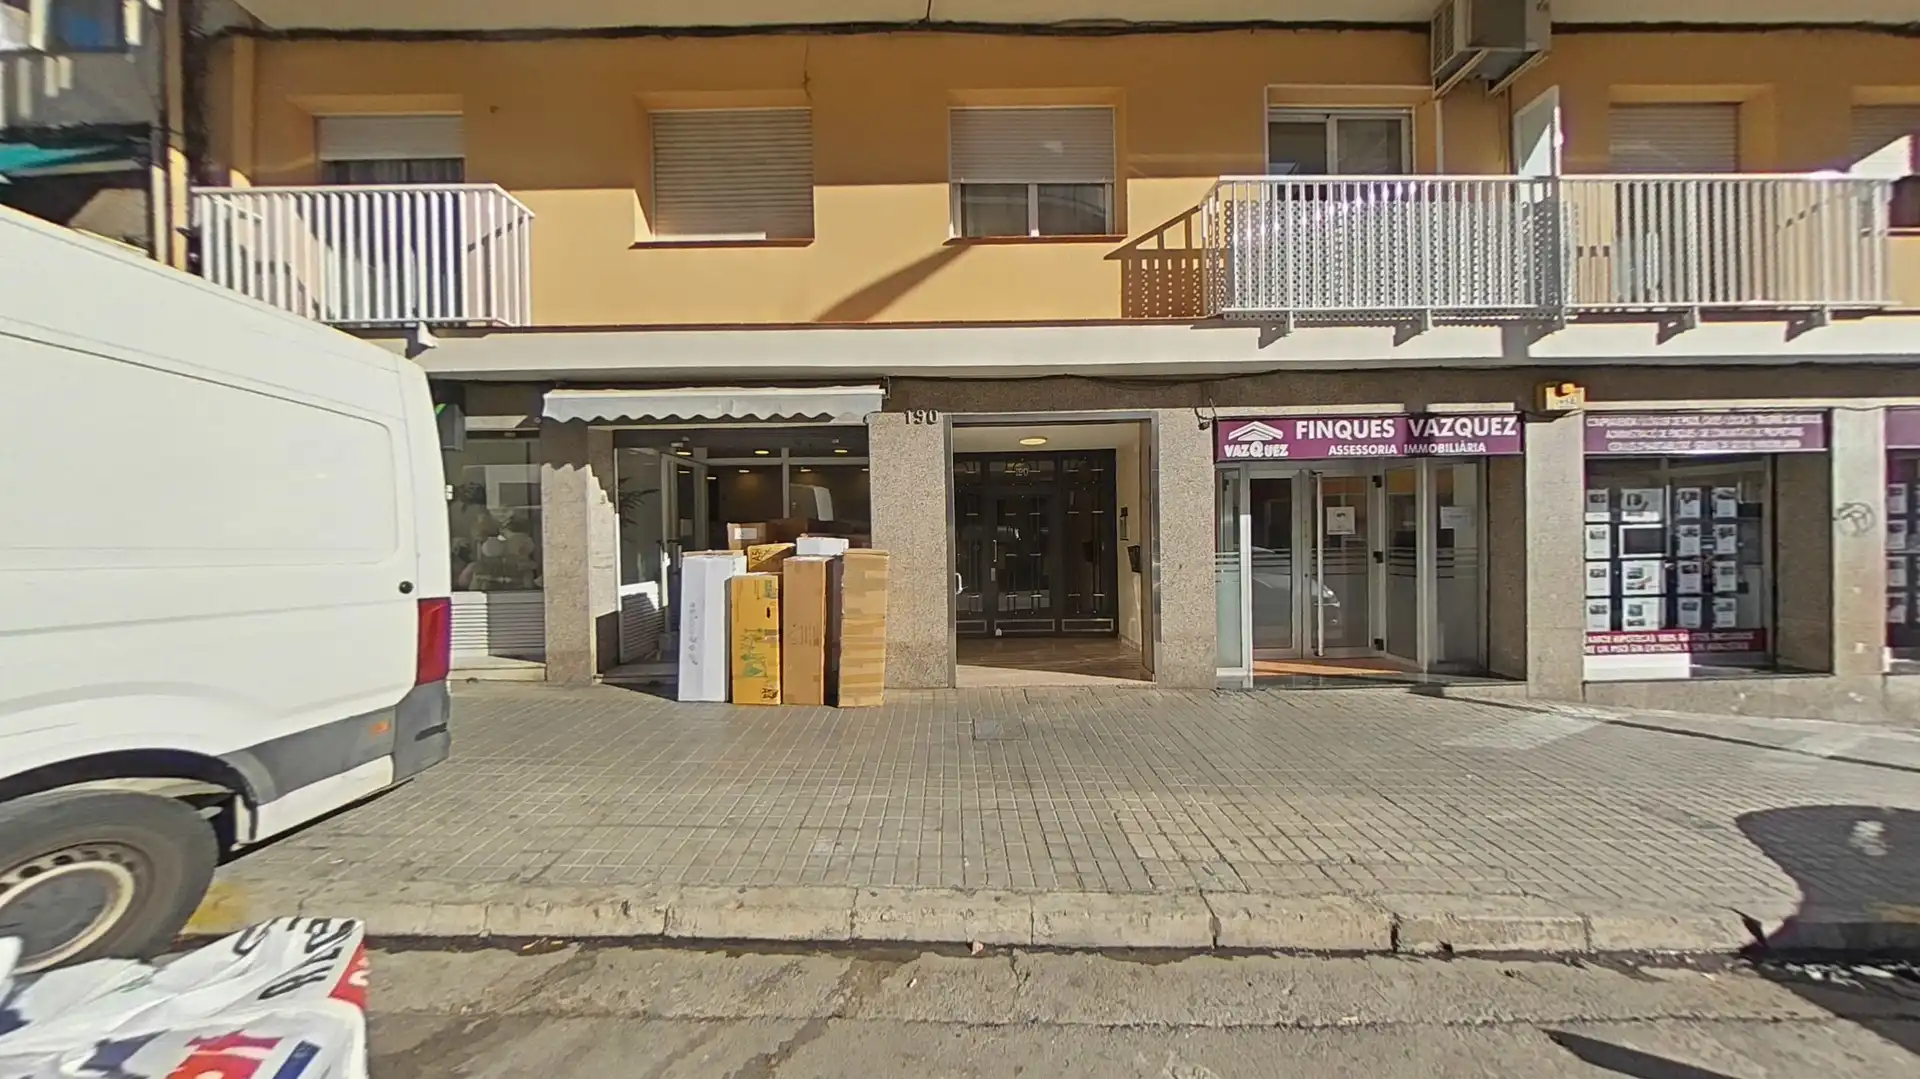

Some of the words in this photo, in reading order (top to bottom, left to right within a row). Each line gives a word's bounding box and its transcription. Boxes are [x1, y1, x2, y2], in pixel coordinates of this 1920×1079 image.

[904, 409, 939, 425] 190
[1296, 419, 1395, 440] FINQUES
[1408, 416, 1518, 438] VAZQUEZ
[1224, 440, 1289, 458] VAZQUEZ
[1328, 444, 1397, 456] ASSESSORIA
